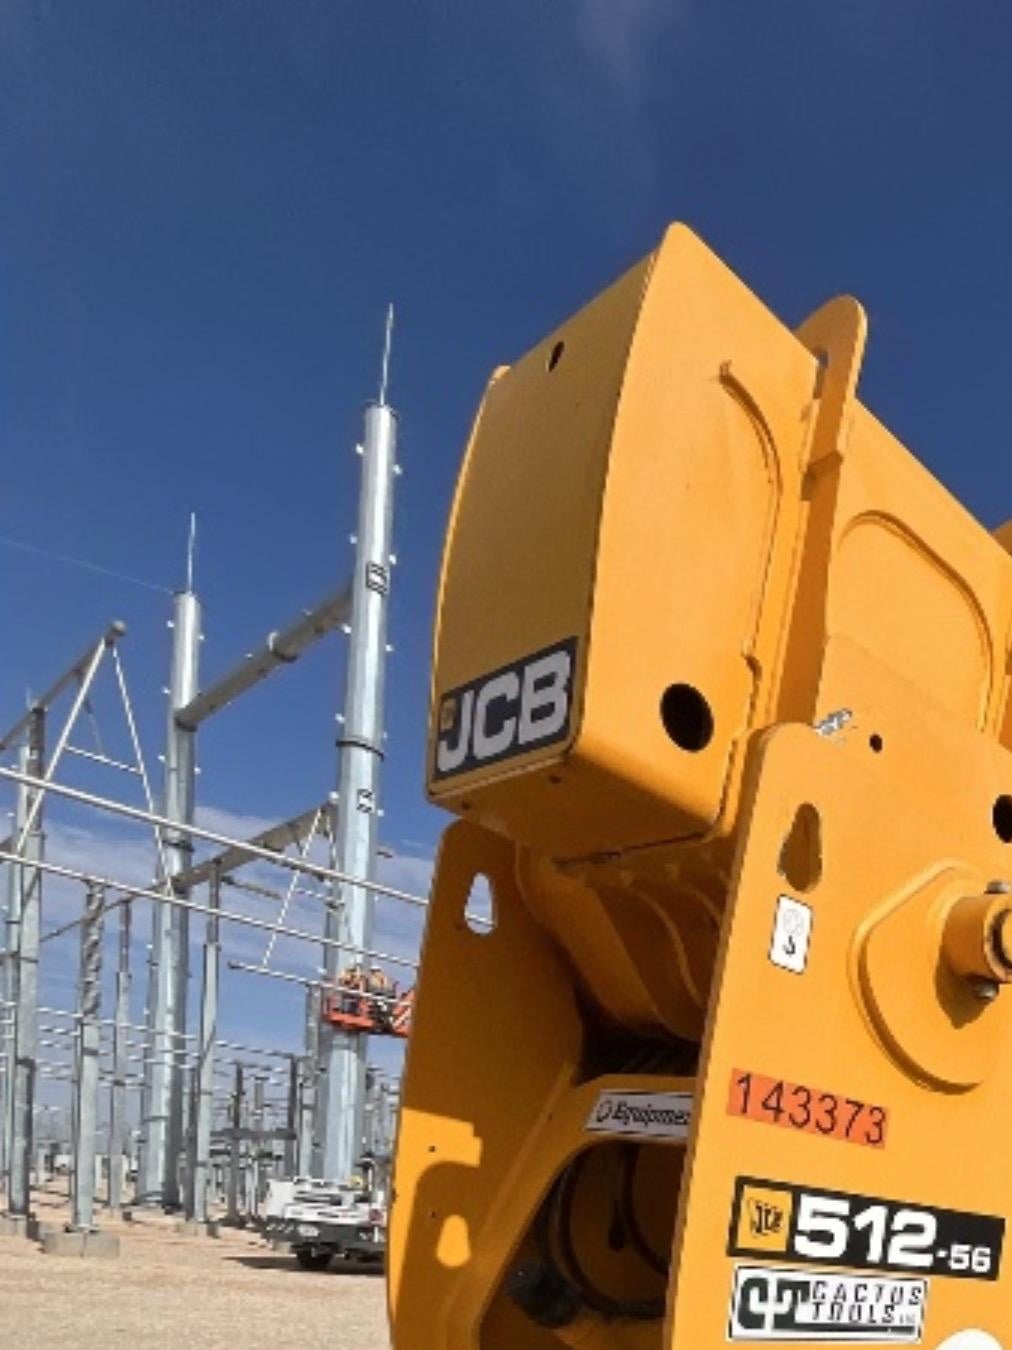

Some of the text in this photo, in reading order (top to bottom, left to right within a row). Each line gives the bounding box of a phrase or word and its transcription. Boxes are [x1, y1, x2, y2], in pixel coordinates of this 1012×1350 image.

[437, 650, 571, 772] JCB
[736, 1072, 888, 1146] 143373
[811, 1302, 896, 1324] TOOLS
[812, 1281, 922, 1306] CACTUS
